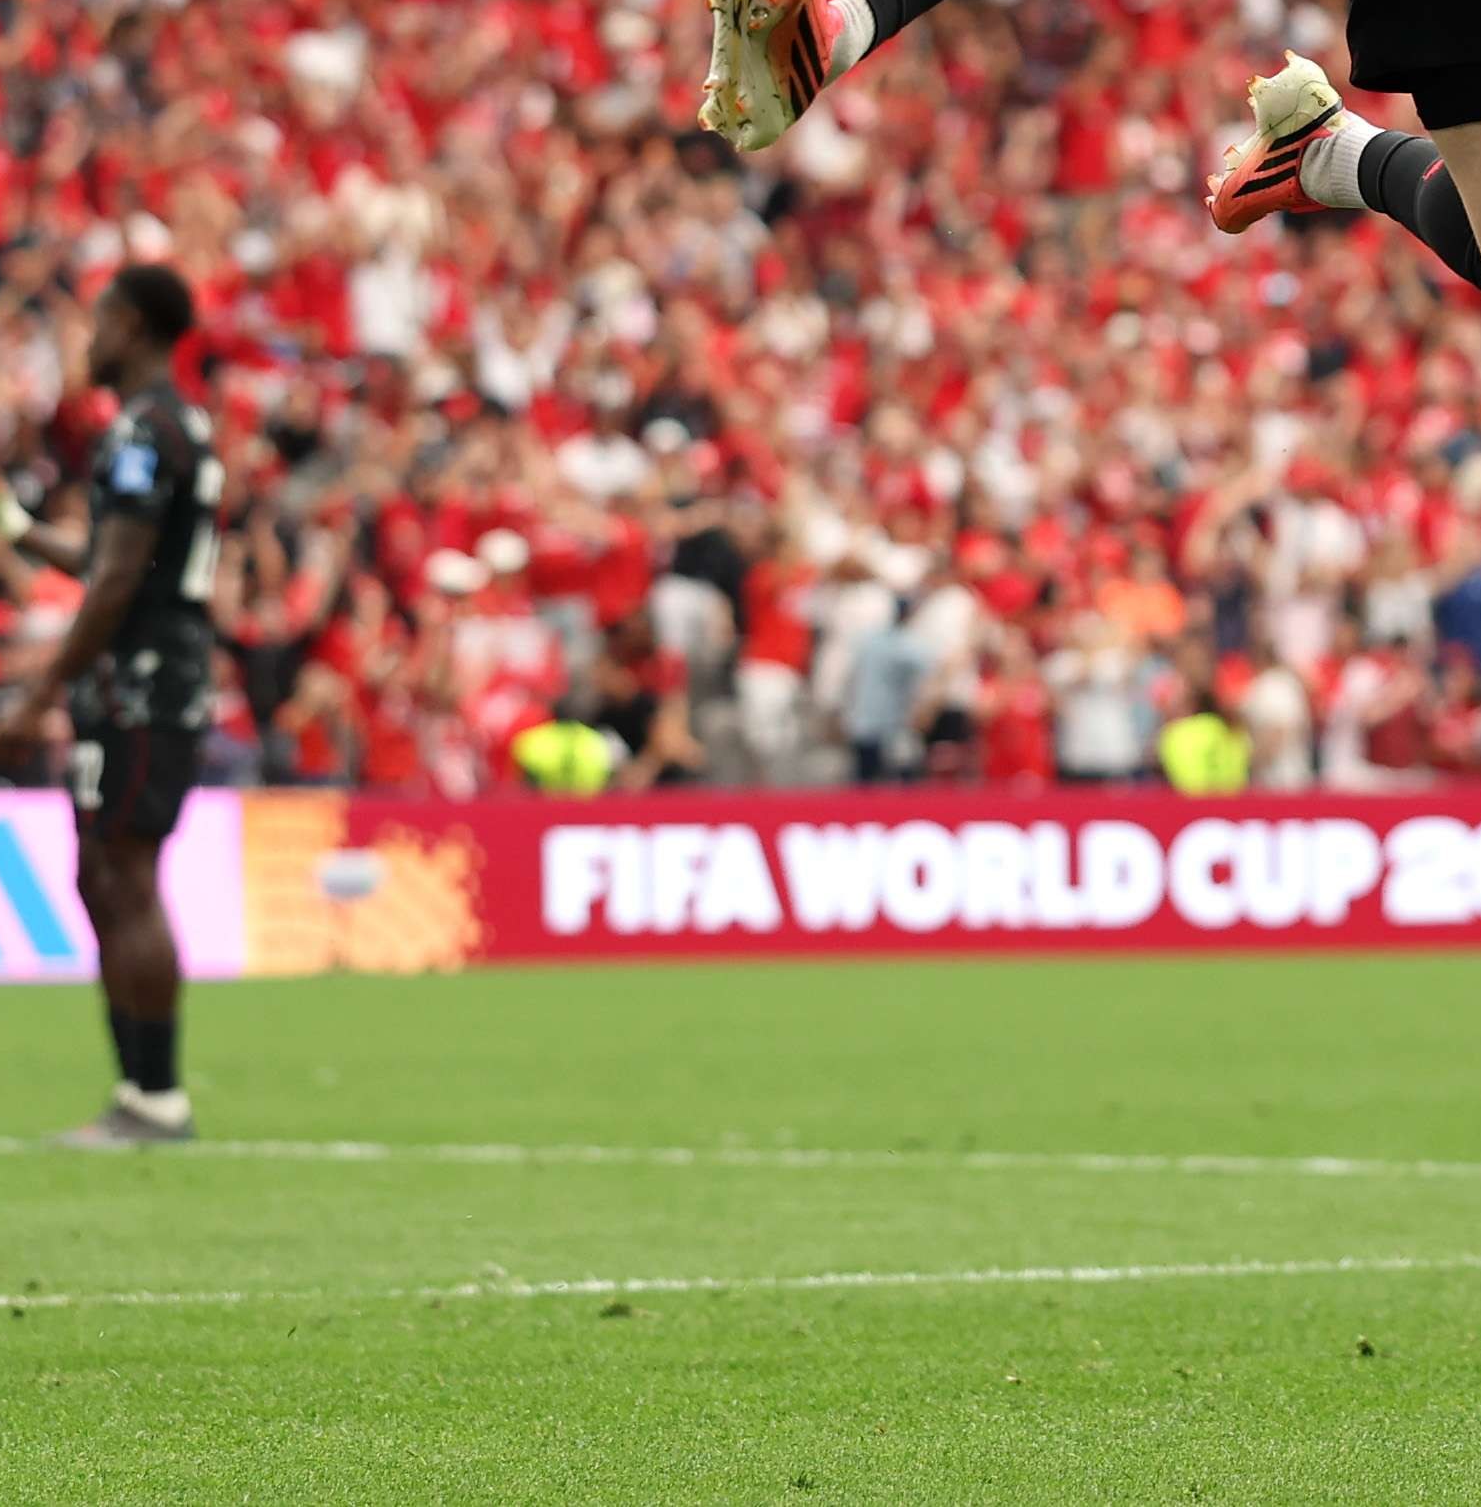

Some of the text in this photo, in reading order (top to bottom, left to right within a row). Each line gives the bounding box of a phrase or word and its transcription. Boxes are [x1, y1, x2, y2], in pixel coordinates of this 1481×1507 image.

[542, 824, 783, 935] FIFA
[777, 819, 1167, 931] WORLD
[1168, 818, 1382, 929] CUP
